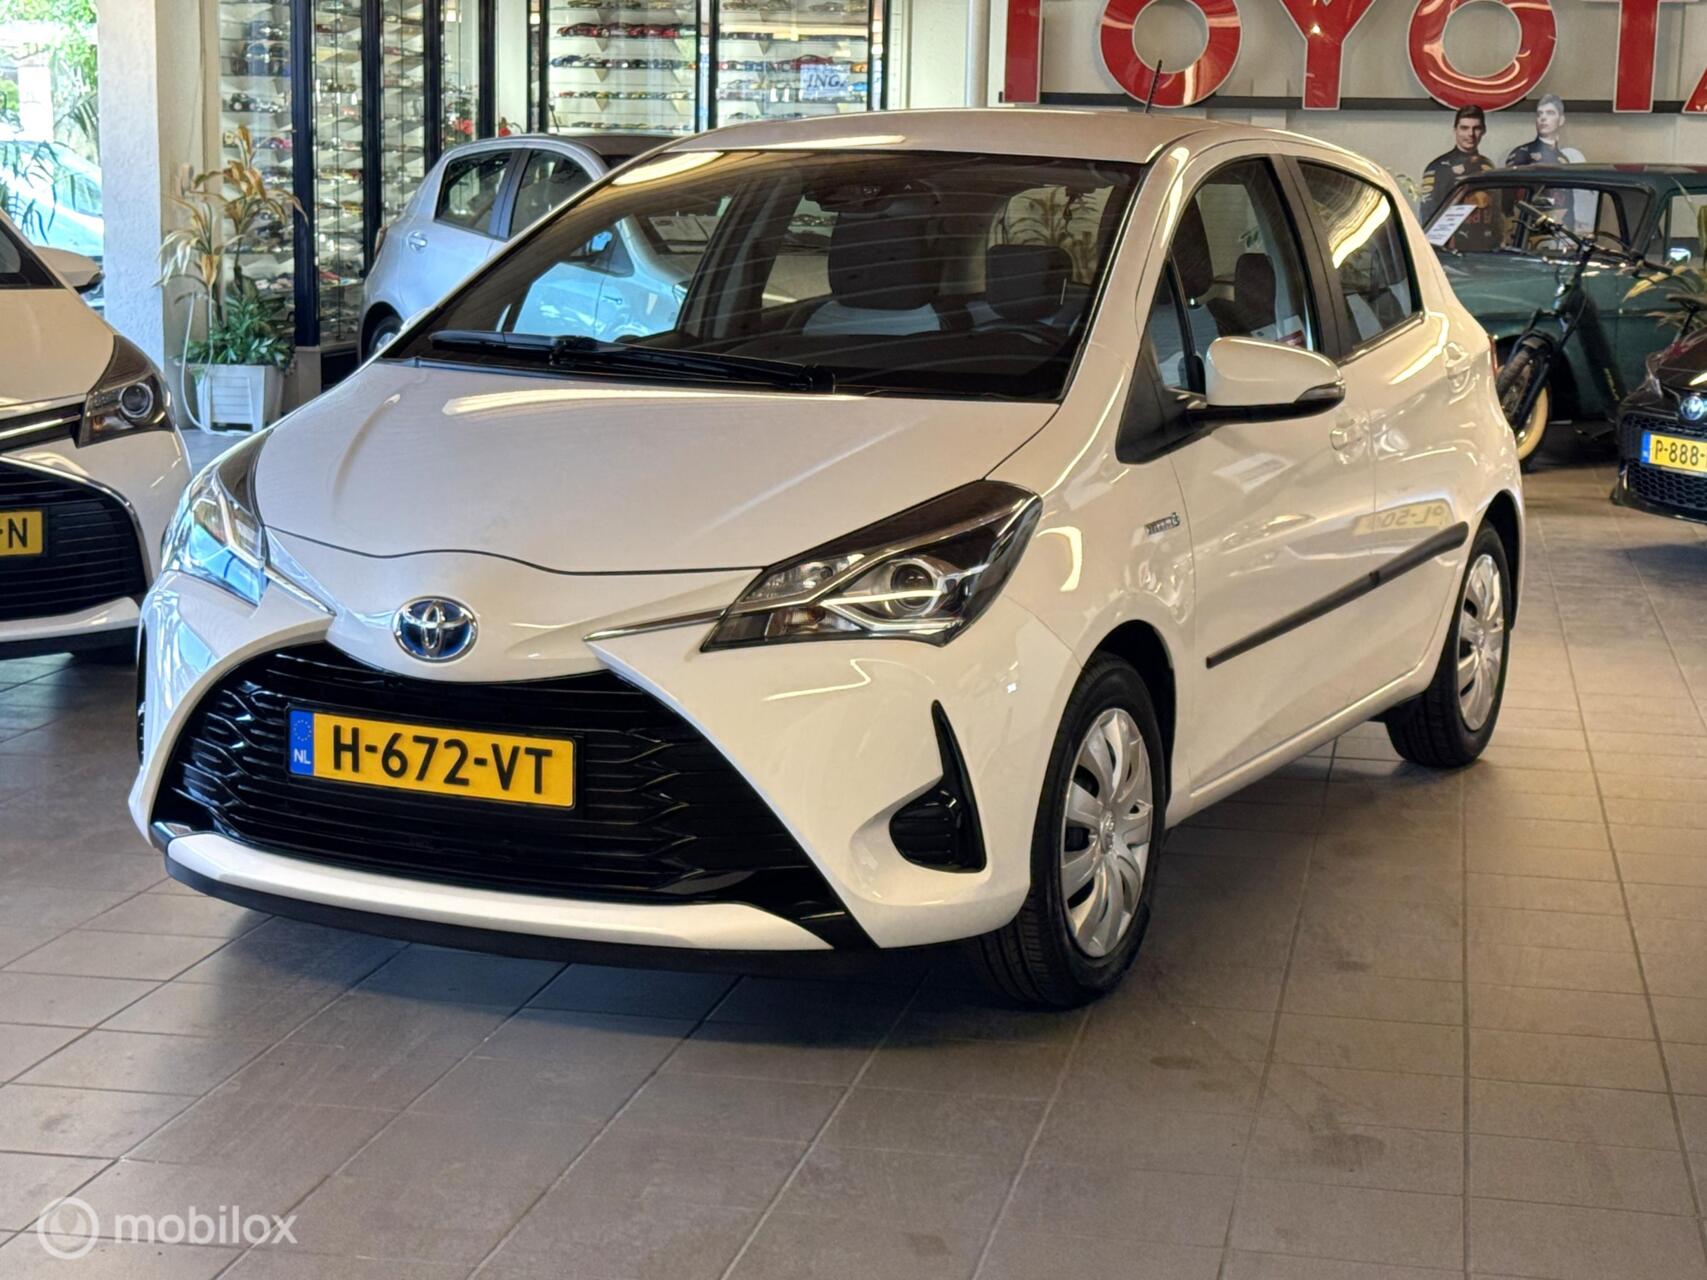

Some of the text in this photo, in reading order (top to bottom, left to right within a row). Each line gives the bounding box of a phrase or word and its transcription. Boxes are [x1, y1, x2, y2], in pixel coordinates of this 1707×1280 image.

[1003, 0, 1707, 112] TOYOT
[1655, 439, 1707, 466] P-888-
[293, 748, 311, 765] NL
[333, 724, 553, 795] H-672-VT
